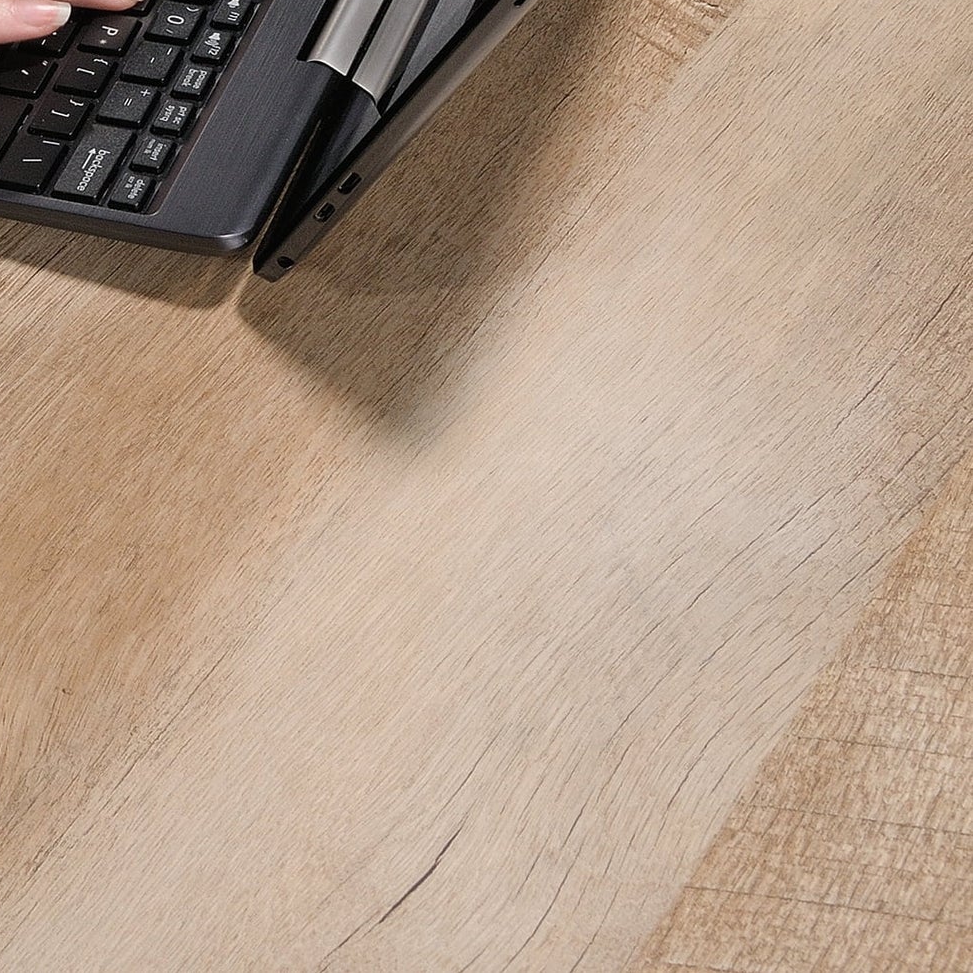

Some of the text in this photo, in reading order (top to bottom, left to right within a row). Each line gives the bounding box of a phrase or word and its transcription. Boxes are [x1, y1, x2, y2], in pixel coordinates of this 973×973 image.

[167, 15, 185, 25] 0
[227, 11, 240, 22] f11
[101, 25, 119, 36] P
[208, 46, 221, 56] f12
[76, 67, 95, 76] [
[182, 68, 198, 87] break
[193, 70, 208, 90] pause
[140, 88, 151, 97] +
[123, 98, 133, 107] =
[51, 109, 70, 118] ]
[159, 104, 176, 122] sysrq
[172, 105, 188, 125] prt sc
[149, 142, 165, 161] insert
[77, 148, 110, 191] backspace
[127, 178, 146, 200] delete
